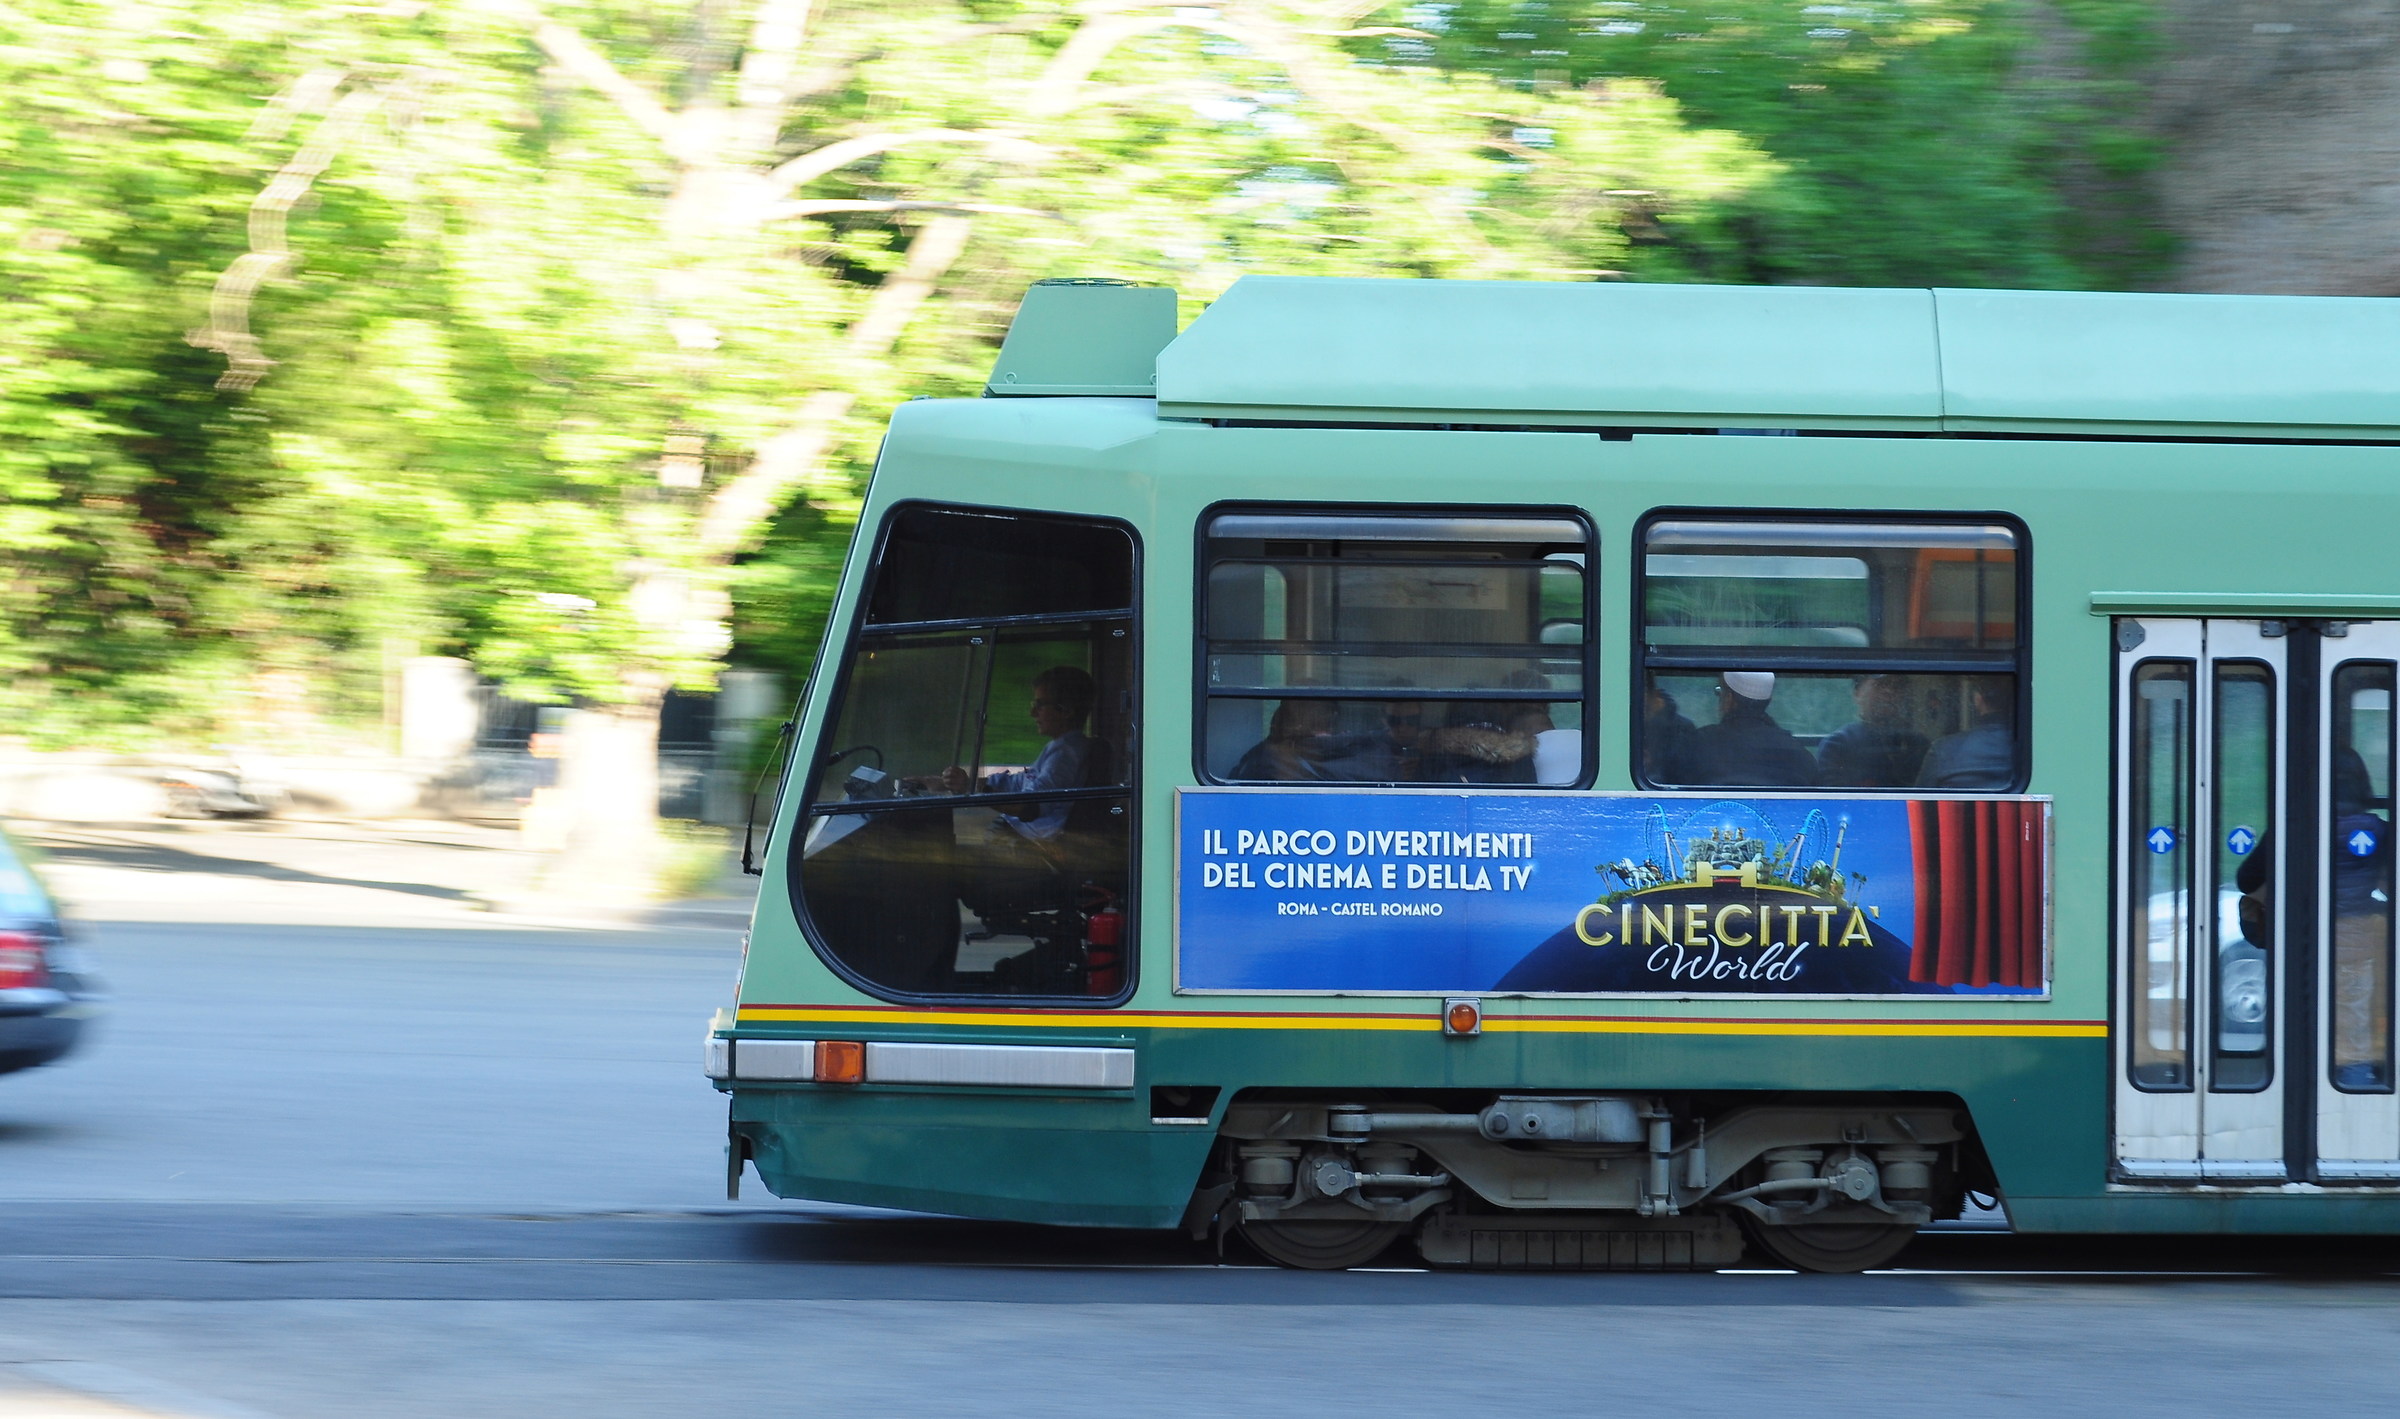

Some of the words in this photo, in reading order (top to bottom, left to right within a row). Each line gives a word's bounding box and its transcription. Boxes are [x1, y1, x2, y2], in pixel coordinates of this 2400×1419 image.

[1203, 829, 1228, 855] IL
[1237, 829, 1337, 856] PARCO
[1346, 830, 1533, 858] DIVERTIMENTI
[1203, 863, 1256, 888] DEL
[1264, 863, 1373, 890] CINEMA
[1382, 864, 1397, 889] E
[1407, 865, 1492, 891] DELLA
[1499, 865, 1532, 891] TV
[1277, 902, 1319, 916] ROMA
[1331, 902, 1378, 916] CASTEL
[1381, 902, 1443, 917] ROMANO
[1646, 934, 1810, 982] World
